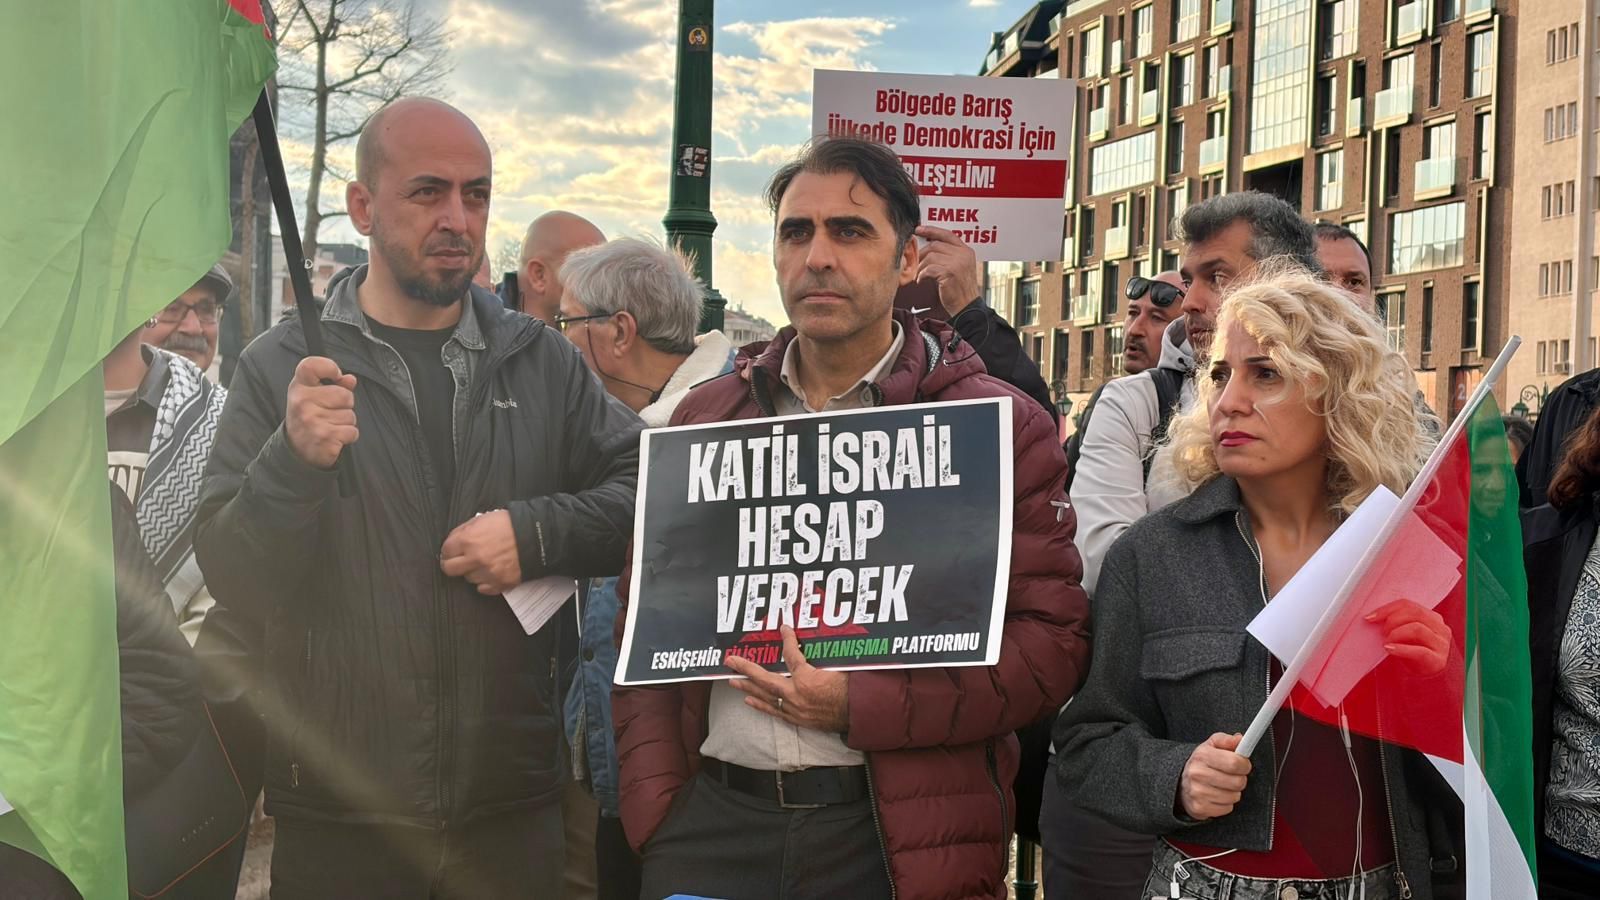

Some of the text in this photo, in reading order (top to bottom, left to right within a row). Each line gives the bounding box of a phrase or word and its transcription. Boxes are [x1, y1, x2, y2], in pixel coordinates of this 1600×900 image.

[876, 89, 1013, 125] Bölgede Barış
[903, 122, 1014, 150] Demokrasi
[1019, 122, 1056, 158] İçin
[898, 157, 996, 195] RLEŞELİM!
[927, 207, 979, 222] EMEK
[687, 414, 961, 503] KATİL İSRAİL
[737, 499, 884, 568] HESAP
[716, 564, 914, 634] VERECEK
[651, 646, 722, 672] ESKİŞEHİR
[804, 638, 889, 660] DAYANIŞMA
[891, 632, 980, 654] PLATFORMU
